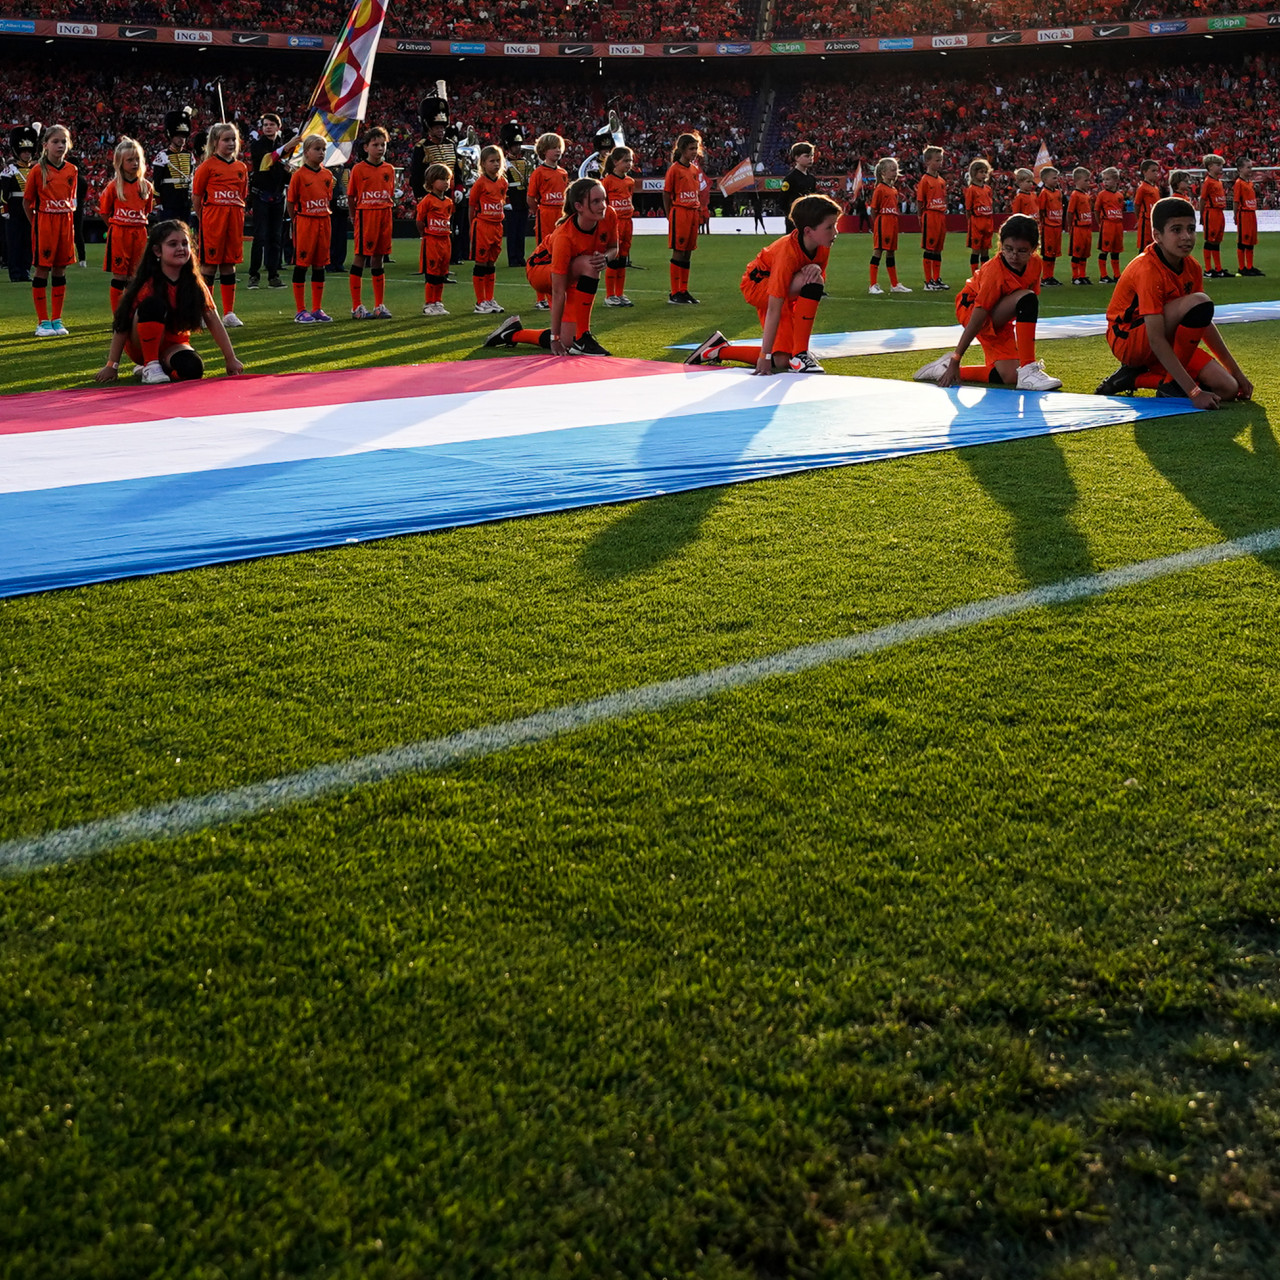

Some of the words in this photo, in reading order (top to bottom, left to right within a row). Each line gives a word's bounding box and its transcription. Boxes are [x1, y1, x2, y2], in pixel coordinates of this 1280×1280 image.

[1224, 18, 1239, 27] kpn
[59, 26, 80, 34] ING
[177, 32, 195, 40] ING
[1040, 31, 1058, 39] ING
[406, 43, 431, 51] bitvavo
[786, 43, 800, 51] kpn
[834, 42, 859, 50] bitvavo
[934, 39, 952, 47] ING
[506, 45, 525, 53] ING
[611, 46, 630, 54] ING
[362, 191, 381, 199] ING
[546, 192, 562, 200] ING
[46, 200, 66, 208] ING
[306, 199, 325, 208] ING
[611, 199, 628, 207] ING
[116, 208, 136, 218] ING
[430, 218, 449, 226] ING
